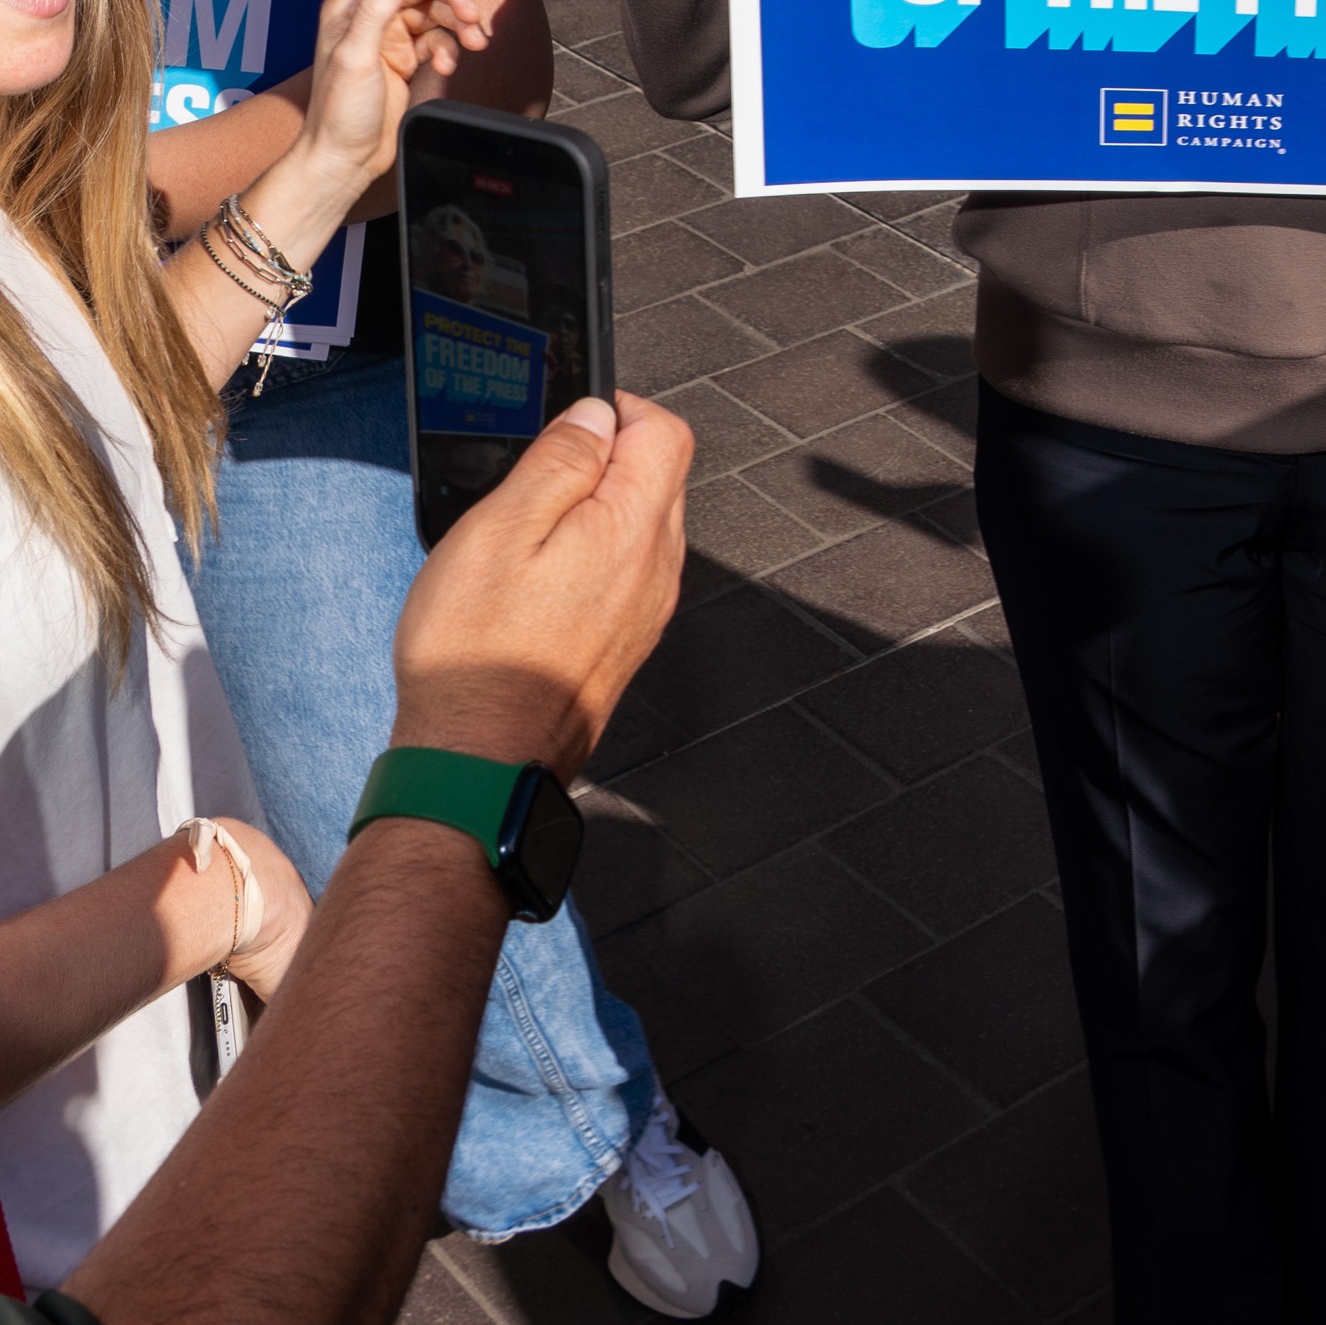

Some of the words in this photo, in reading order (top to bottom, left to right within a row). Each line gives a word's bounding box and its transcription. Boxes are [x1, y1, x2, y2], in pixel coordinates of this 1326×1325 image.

[1177, 90, 1284, 107] HUMAN
[1176, 113, 1283, 130] RIGHTS
[1176, 136, 1281, 149] CAMPAIGN
[424, 312, 502, 349] PROTECT
[505, 336, 530, 357] THE
[424, 332, 530, 385] FREEDOM
[425, 367, 446, 389] OF
[452, 372, 482, 395] THE
[486, 379, 528, 404] PRESS
